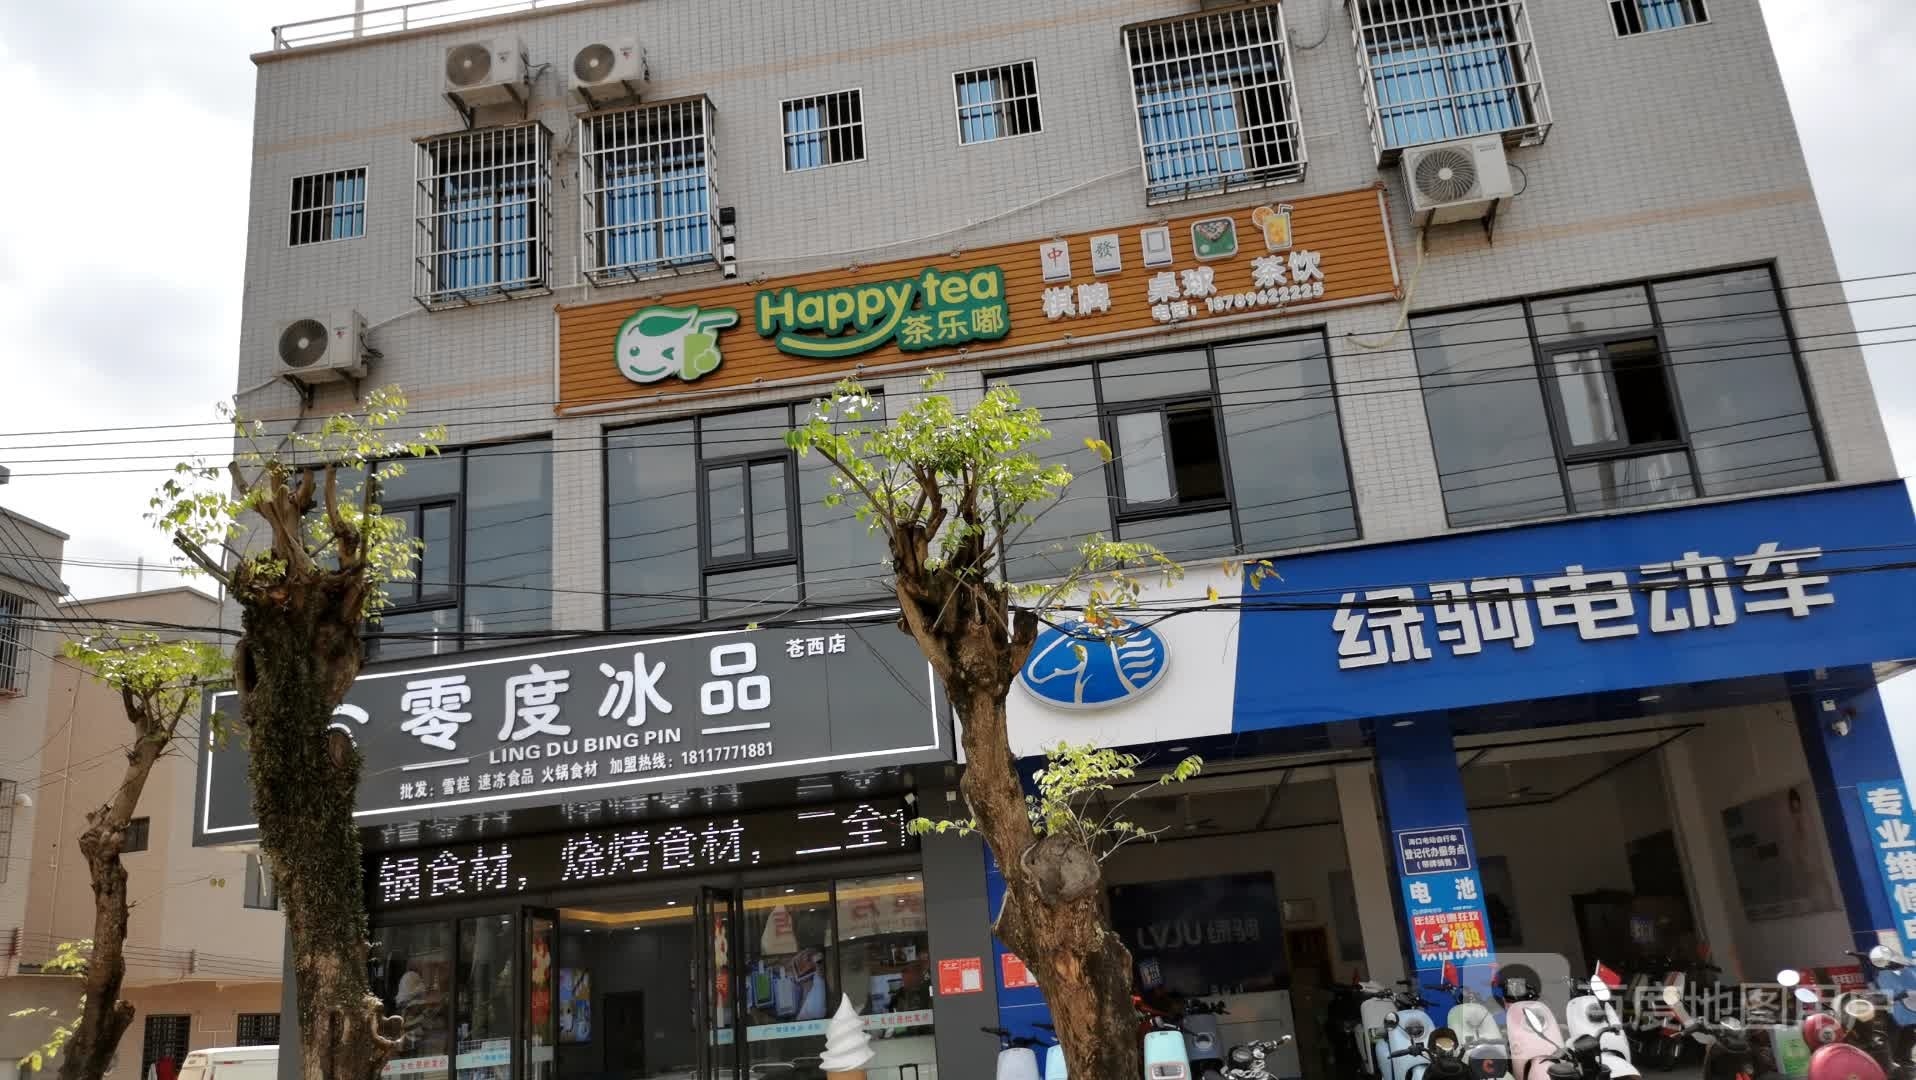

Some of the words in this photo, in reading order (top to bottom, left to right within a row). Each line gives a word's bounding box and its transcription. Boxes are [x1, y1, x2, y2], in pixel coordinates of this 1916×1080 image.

[1148, 265, 1217, 303] 桌球
[1252, 250, 1324, 288] 茶饮
[761, 283, 911, 347] Happy
[923, 271, 999, 306] tea
[1041, 282, 1112, 320] 棋牌
[1205, 282, 1324, 313] 18789622225
[902, 305, 1003, 345] 茶乐嘟
[1331, 542, 1834, 669] 绿驹电动车
[785, 633, 847, 659] 苍西店
[401, 642, 770, 751] 零度冰品
[489, 744, 541, 764] LING
[546, 740, 578, 757] DU
[585, 732, 639, 753] BING
[644, 727, 681, 746] PIN
[442, 776, 471, 795] 雪糕
[478, 767, 534, 791] 速冻食品
[541, 760, 598, 784] 火锅食材
[609, 751, 673, 775] 加盟热线：
[681, 741, 773, 765] 18117771881
[1404, 844, 1466, 860] 登记代办服务点
[1409, 881, 1431, 904] 电
[1455, 876, 1478, 900] 池
